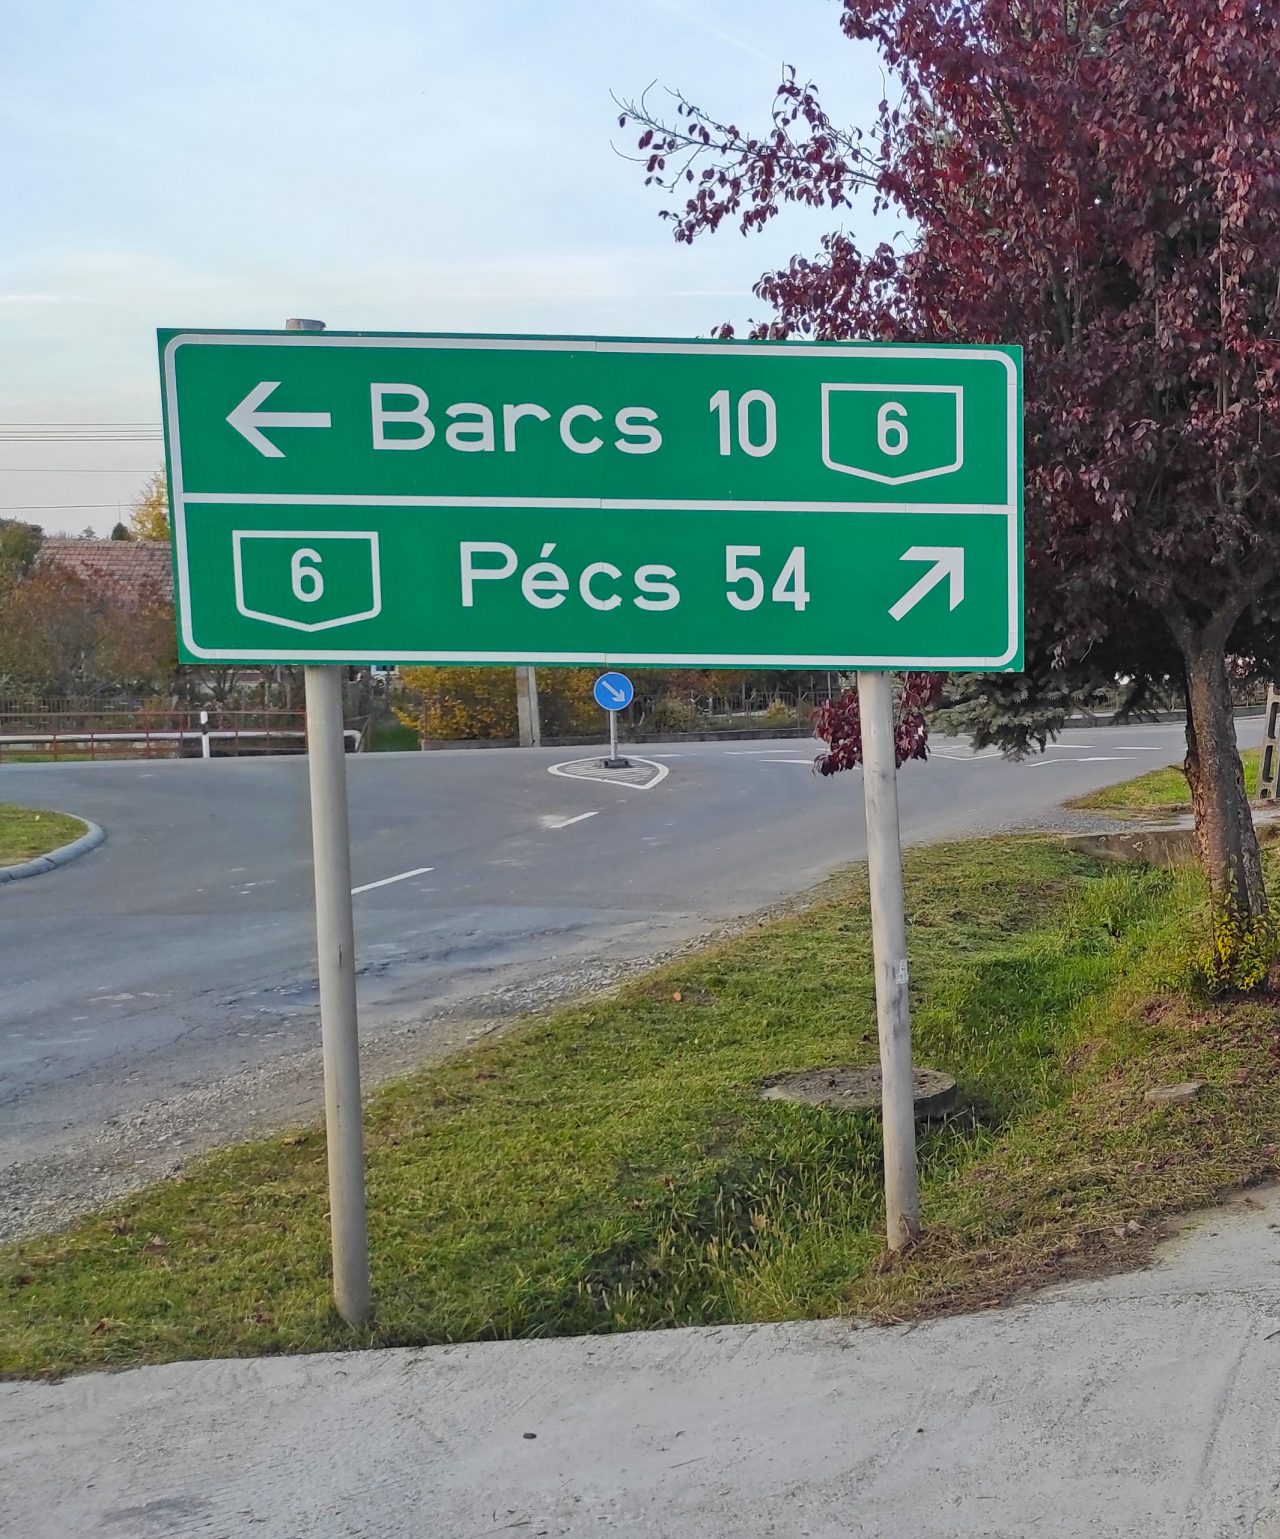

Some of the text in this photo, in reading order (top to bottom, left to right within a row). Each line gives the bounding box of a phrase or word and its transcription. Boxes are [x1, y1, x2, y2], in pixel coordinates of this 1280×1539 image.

[370, 382, 911, 459] Barcs 10 6
[291, 541, 811, 612] 6 Pécs 54
